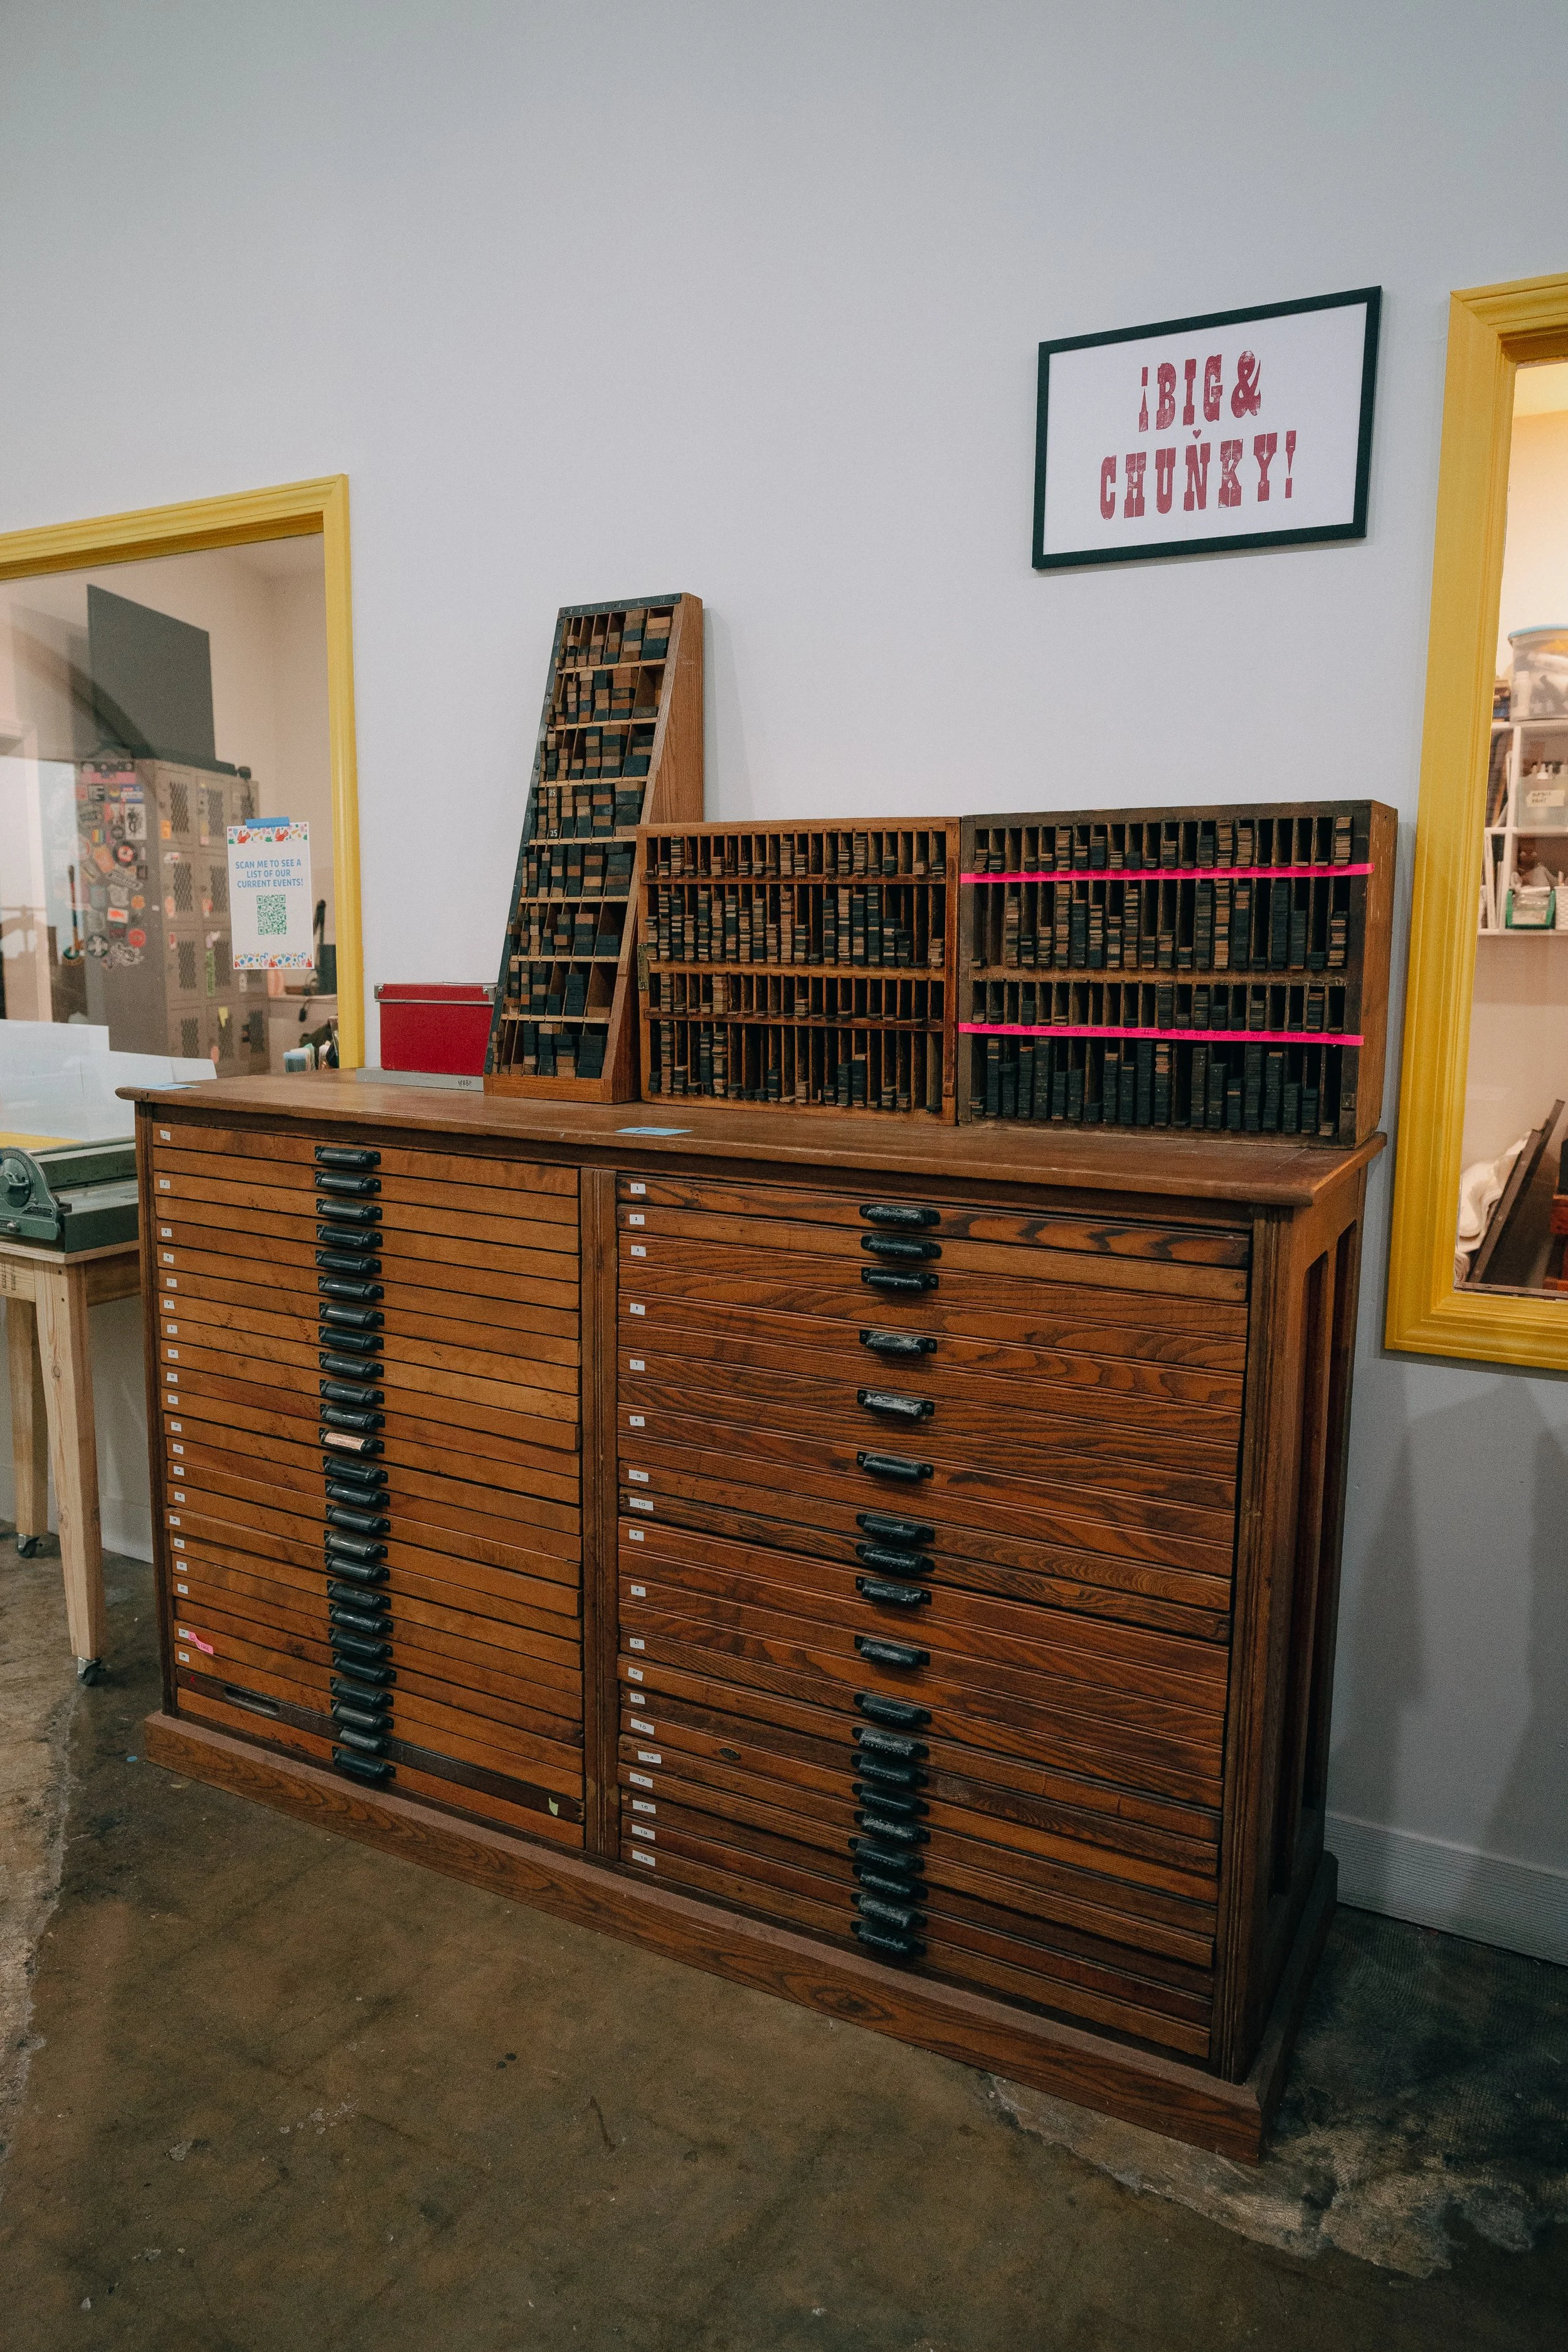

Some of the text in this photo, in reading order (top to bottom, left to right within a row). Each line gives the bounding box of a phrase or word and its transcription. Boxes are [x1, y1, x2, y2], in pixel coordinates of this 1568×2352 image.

[1230, 350, 1262, 418] &
[1099, 430, 1297, 520] CHUNKY!
[235, 861, 255, 869] SCAN
[257, 860, 268, 869] ME
[282, 859, 294, 867] SEE
[296, 859, 302, 867] A
[246, 870, 262, 878] LIST
[275, 869, 291, 877] OUR
[237, 878, 304, 888] CURRENT EVENTS!
